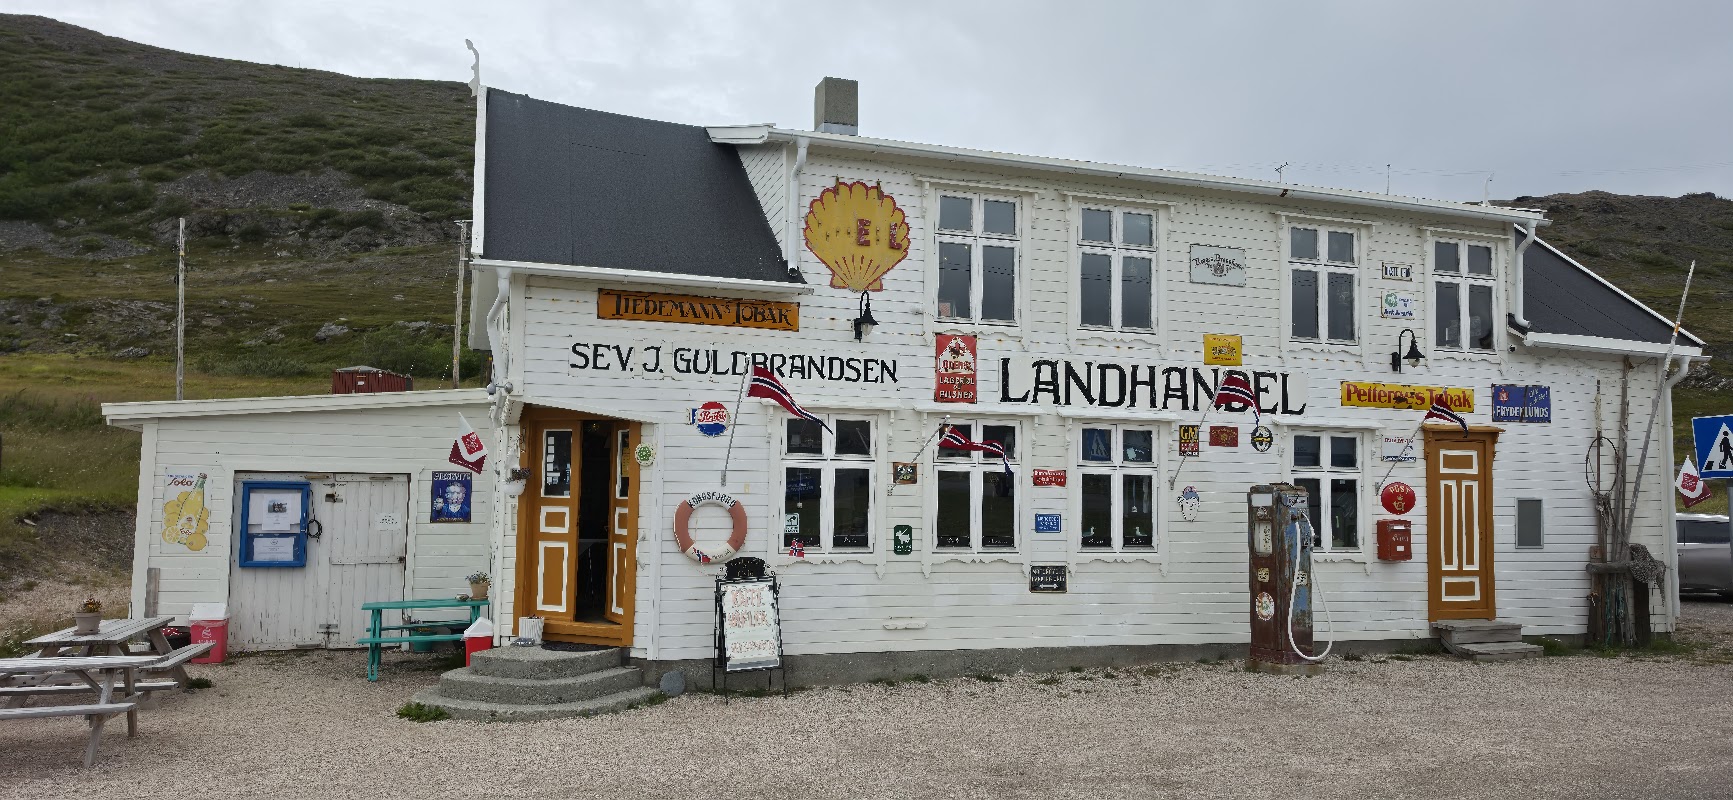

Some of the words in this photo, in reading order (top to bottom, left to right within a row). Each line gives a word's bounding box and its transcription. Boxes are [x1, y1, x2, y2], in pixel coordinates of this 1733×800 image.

[726, 301, 794, 327] TOBAK
[570, 343, 634, 372] SEV.
[674, 348, 899, 384] GULDBRANDSEN
[939, 390, 974, 400] PILSNER
[1388, 485, 1411, 495] POST
[686, 491, 737, 509] KONGSFJORD
